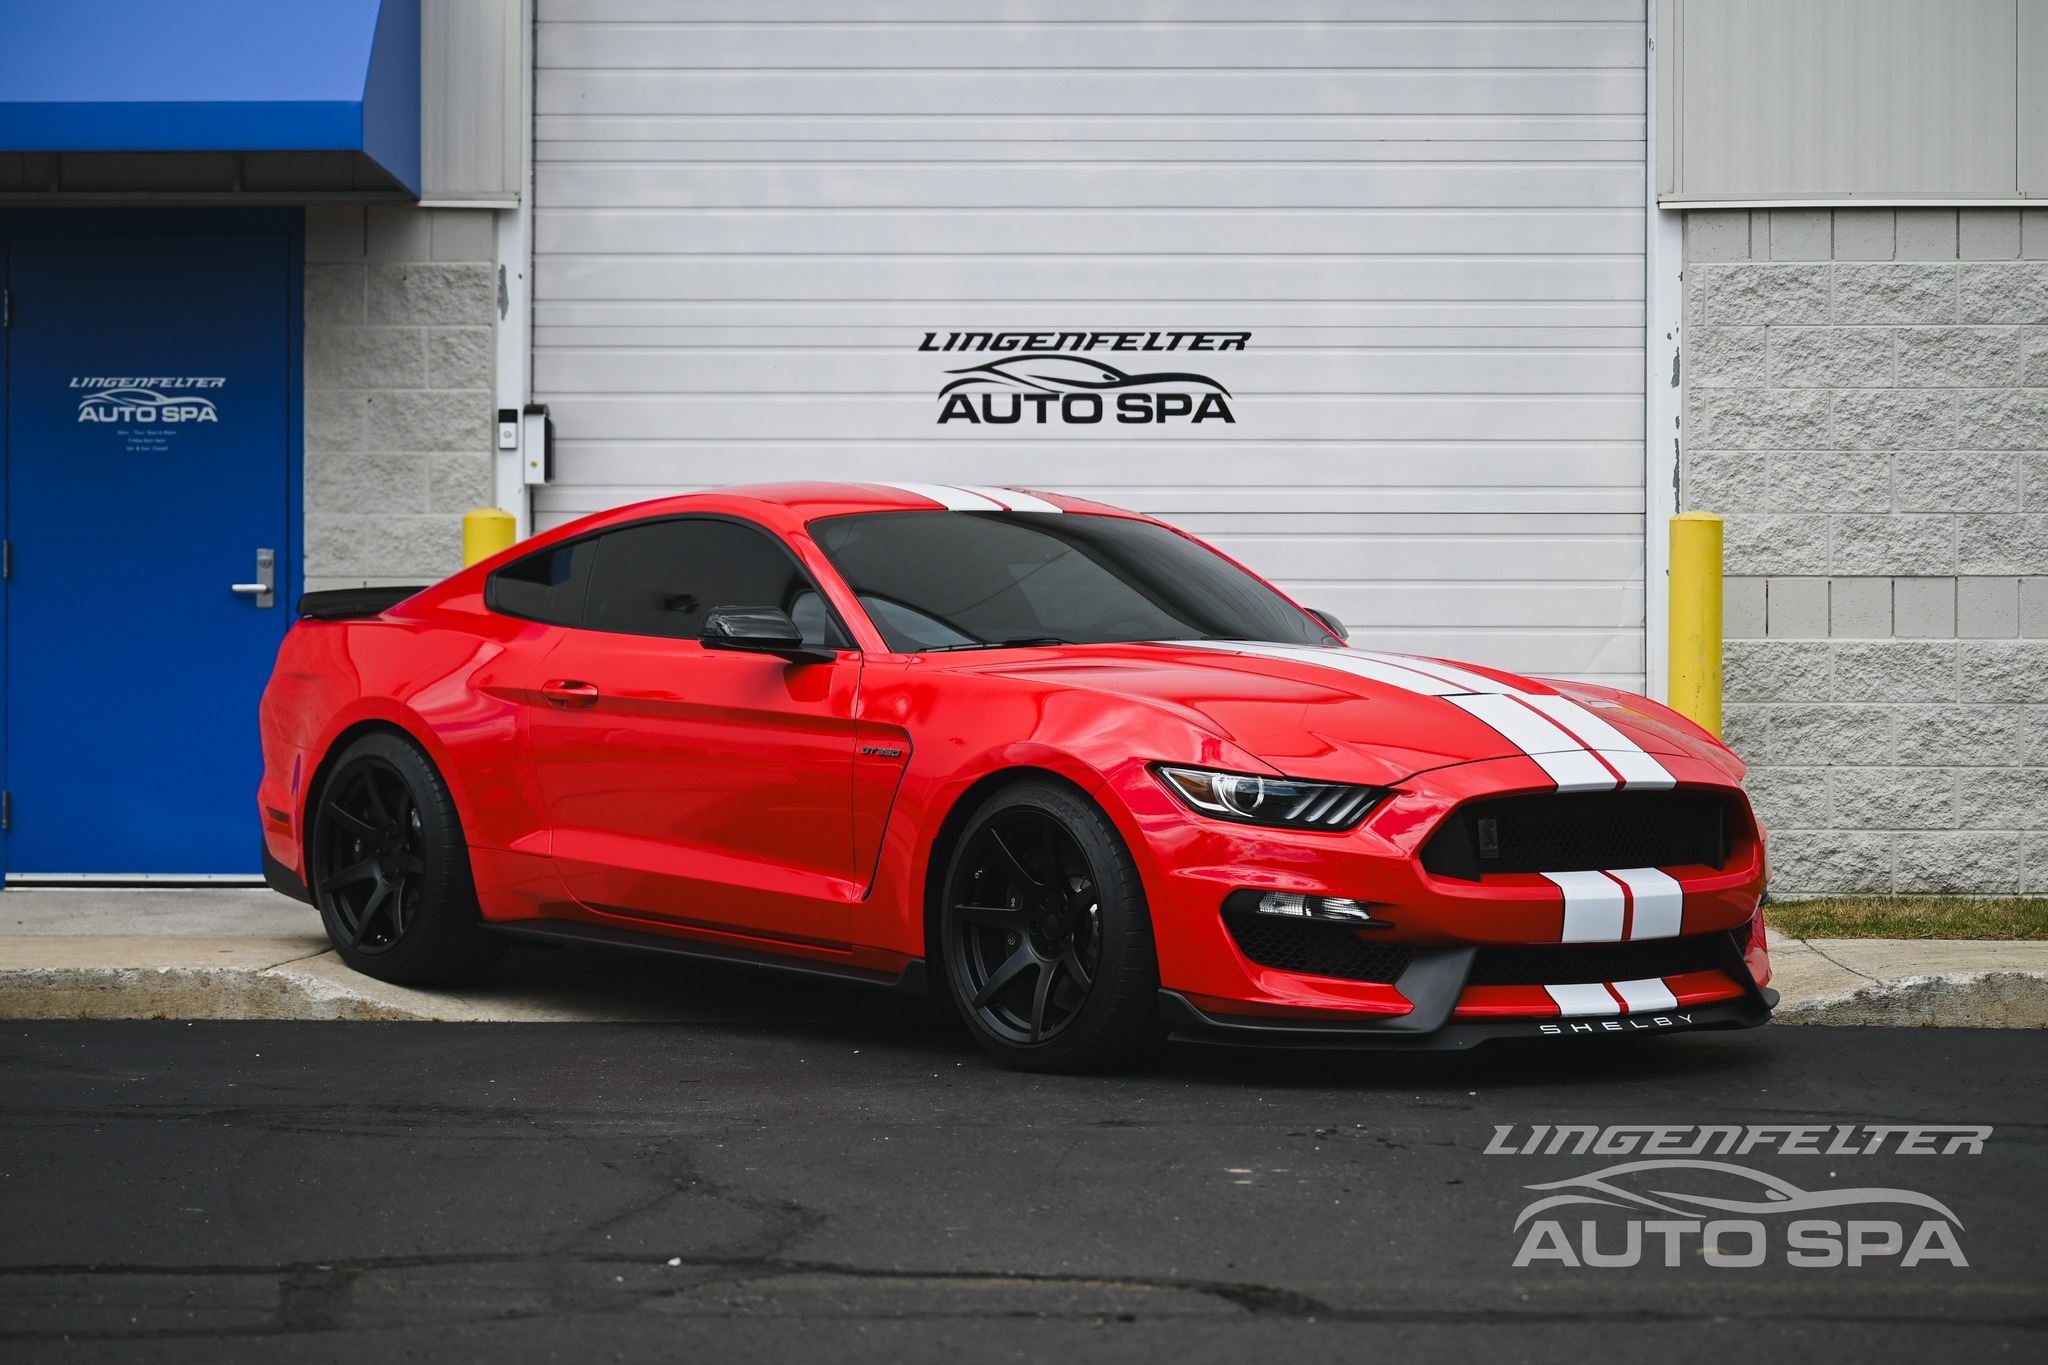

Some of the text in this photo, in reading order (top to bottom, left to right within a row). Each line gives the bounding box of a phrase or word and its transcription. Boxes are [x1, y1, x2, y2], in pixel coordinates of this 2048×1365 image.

[918, 332, 1252, 351] LINGENFELTER
[69, 377, 226, 388] LINGENFELTER
[78, 406, 218, 422] AUTO SPA
[937, 393, 1236, 424] AUTO SPA
[1539, 1013, 1693, 1035] SHELBY
